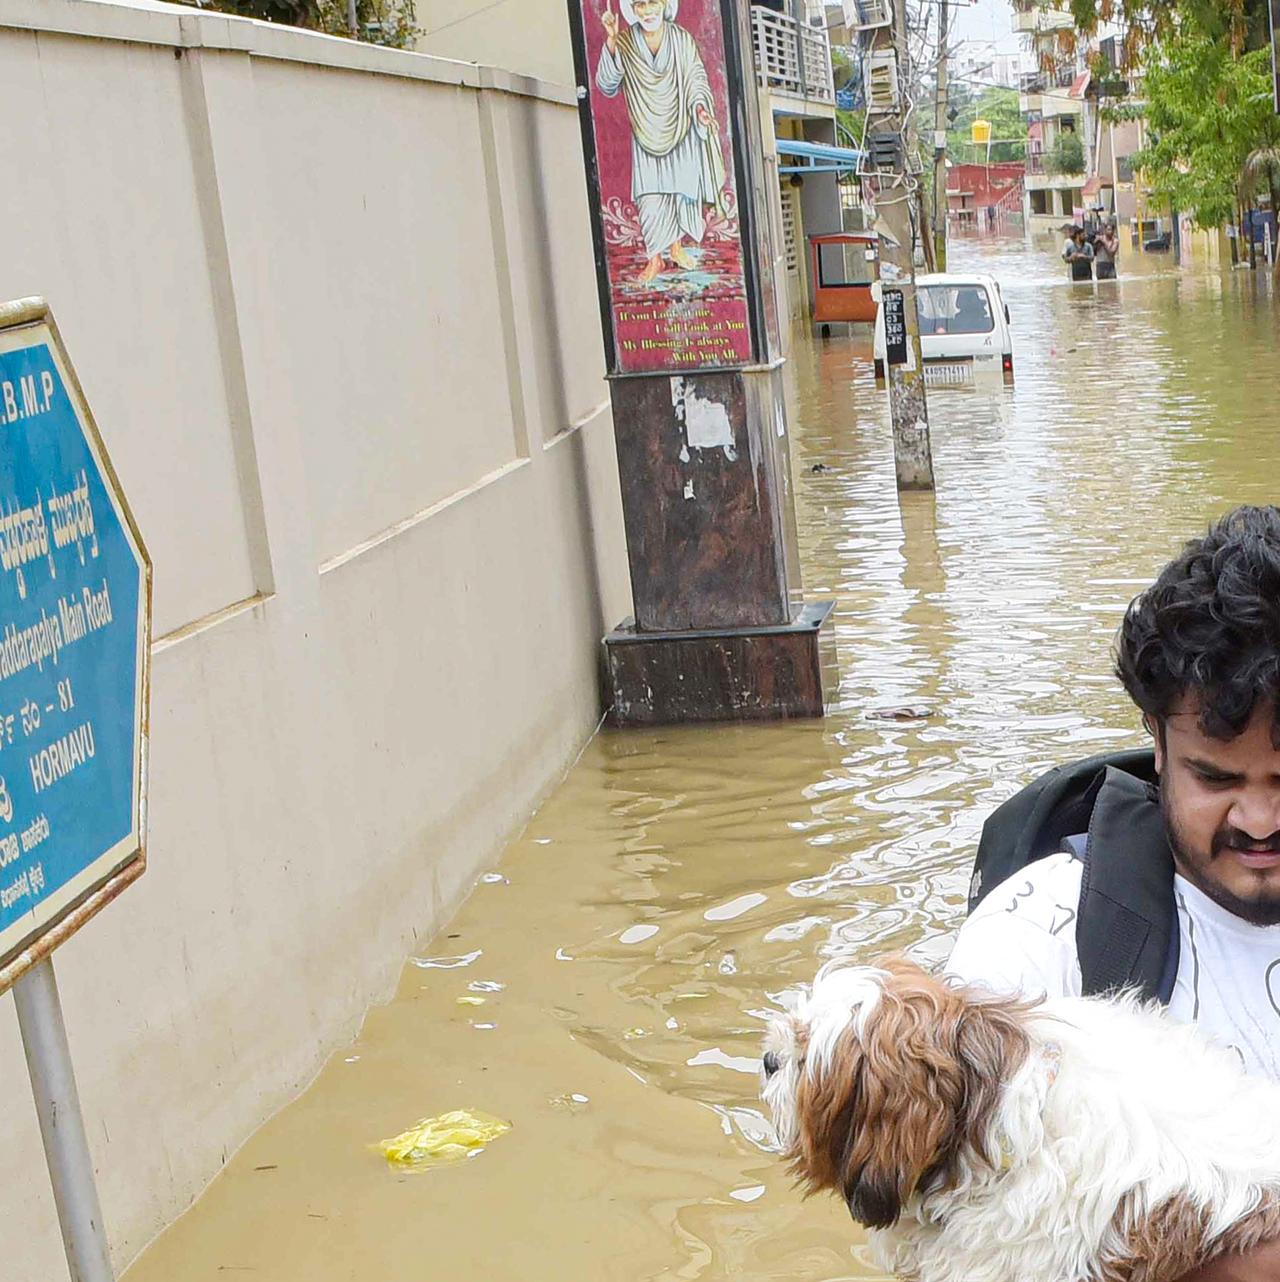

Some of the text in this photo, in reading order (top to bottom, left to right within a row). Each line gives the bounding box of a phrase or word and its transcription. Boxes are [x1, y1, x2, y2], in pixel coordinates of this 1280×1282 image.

[0, 579, 113, 680] addarapalya Main Road
[57, 678, 74, 711] 81
[29, 720, 95, 793] HORMAVU
